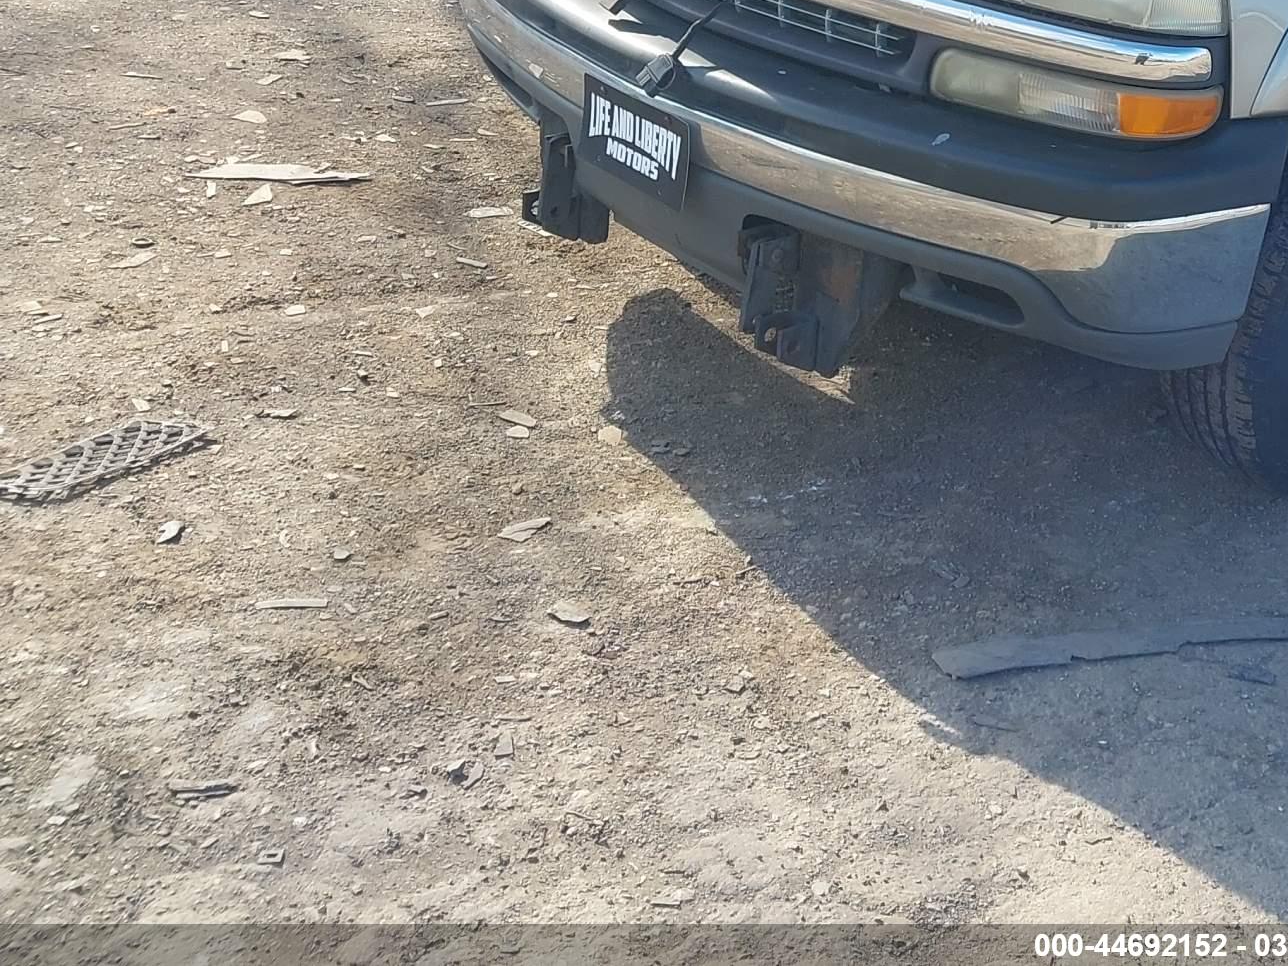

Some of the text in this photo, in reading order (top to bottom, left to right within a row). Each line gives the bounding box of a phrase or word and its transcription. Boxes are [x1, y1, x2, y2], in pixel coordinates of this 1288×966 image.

[588, 91, 681, 181] LIFE AND LIBERTY
[605, 136, 659, 181] MOTORS
